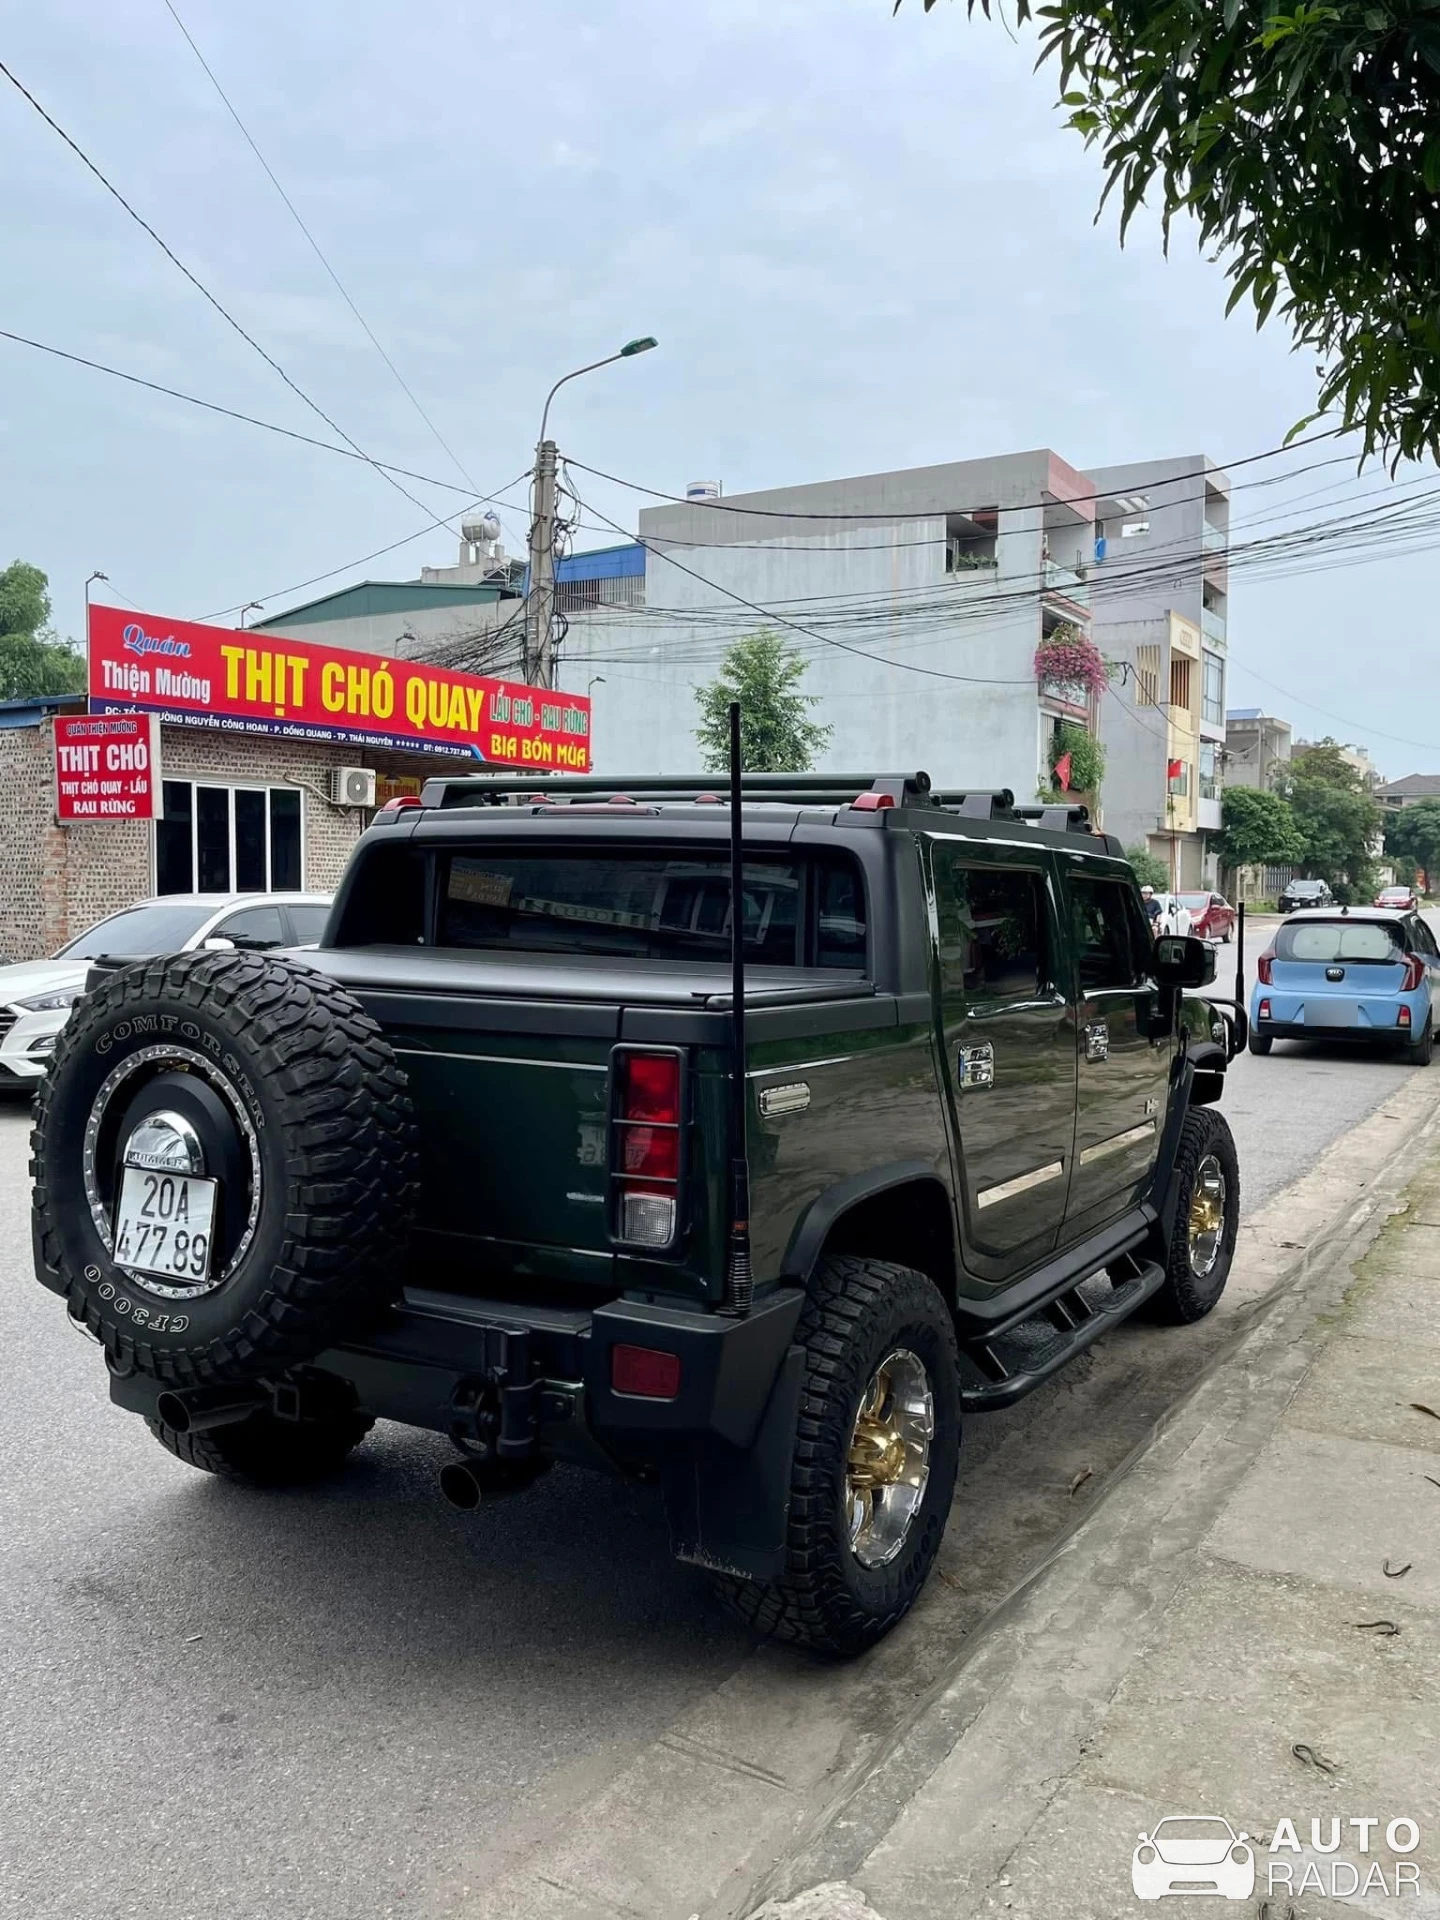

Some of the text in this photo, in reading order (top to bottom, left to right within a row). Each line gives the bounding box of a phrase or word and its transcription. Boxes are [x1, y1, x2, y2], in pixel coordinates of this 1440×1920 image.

[124, 624, 192, 657] Quán
[102, 660, 210, 704] Thiện Mường
[221, 645, 484, 732] THỊT CHÓ QUAY
[185, 714, 219, 727] NGUYỄN
[222, 719, 244, 730] CÔNG
[246, 723, 268, 732] HOAN
[306, 728, 331, 739] QUANG
[338, 732, 348, 741] TP.
[350, 733, 364, 742] THÁI
[366, 736, 393, 746] NGUYÊN
[512, 696, 533, 728] CHÓ
[541, 703, 561, 732] RAU
[562, 702, 588, 736] RỪNG
[59, 738, 147, 777] THỊT CHÓ
[491, 734, 517, 758] BIA
[522, 733, 552, 762] BỐN
[61, 781, 79, 797] THỊT
[81, 779, 98, 794] CHÓ
[101, 780, 122, 795] QUAY
[73, 801, 97, 814] RAU
[95, 1014, 266, 1129] COMFORSER
[141, 1175, 188, 1224] 20A
[117, 1219, 207, 1276] 477.89
[84, 1264, 190, 1333] CF3000
